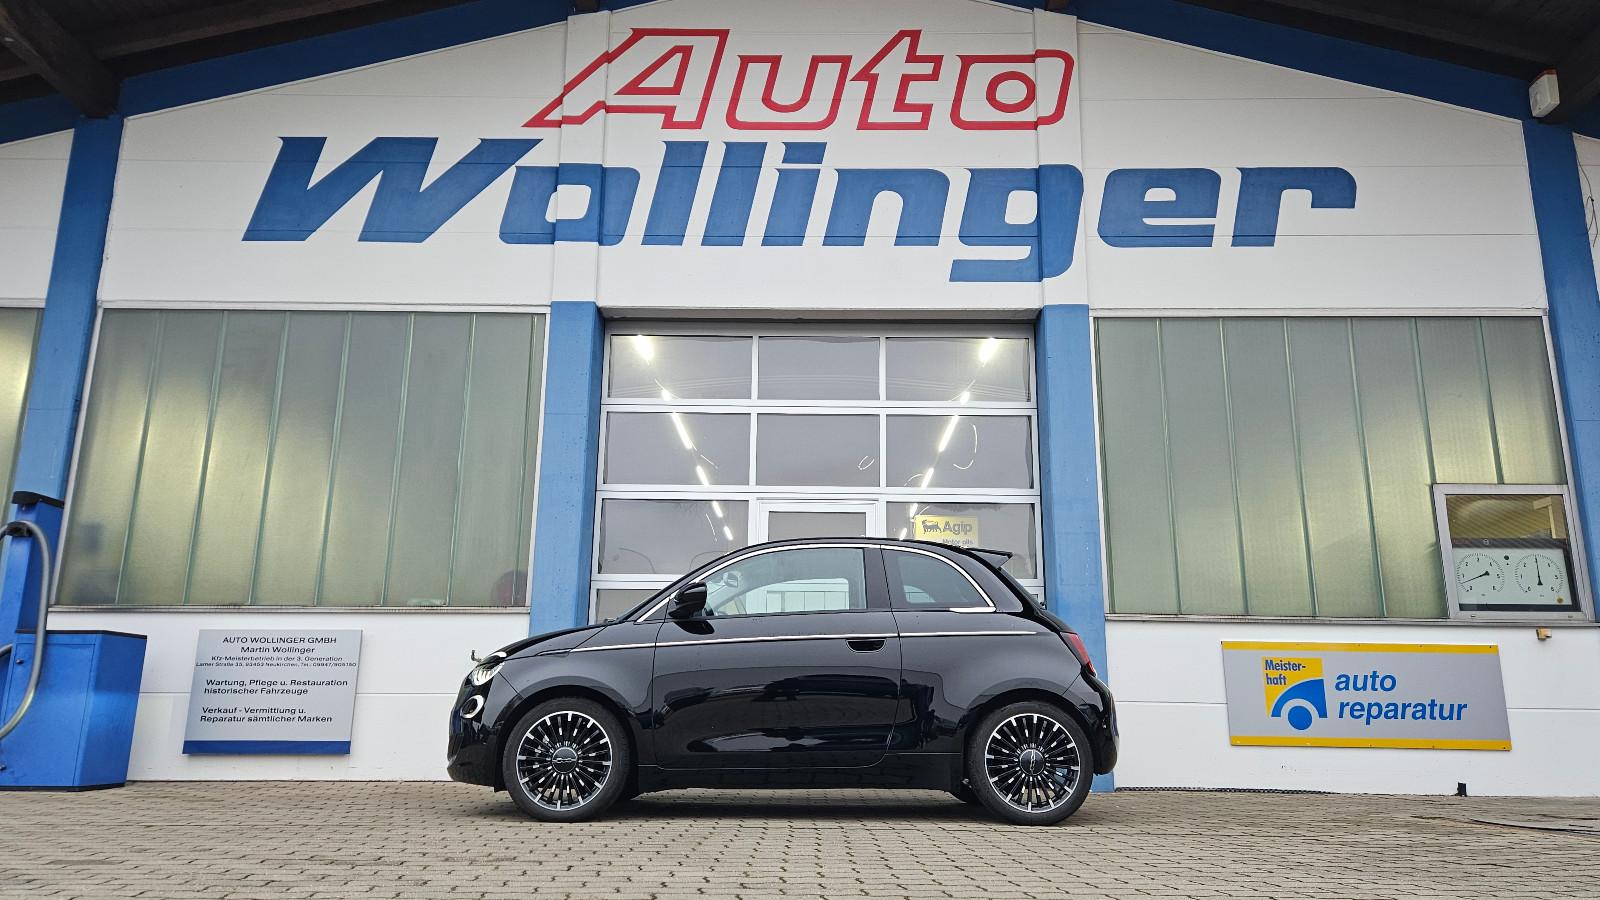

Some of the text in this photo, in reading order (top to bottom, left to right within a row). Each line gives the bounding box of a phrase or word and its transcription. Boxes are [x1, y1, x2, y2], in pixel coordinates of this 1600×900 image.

[522, 28, 1075, 130] Auto
[242, 136, 1357, 283] Wollinger
[942, 520, 972, 535] Agip
[222, 636, 248, 644] AUTO
[1264, 660, 1306, 672] Meister-
[206, 679, 247, 687] Wartung,
[1266, 673, 1287, 686] haft
[1335, 670, 1397, 692] auto
[260, 687, 308, 695] Fahrzeuge
[244, 707, 296, 715] Vermittlung
[1338, 698, 1468, 725] reparatur
[200, 715, 245, 723] Reparatur
